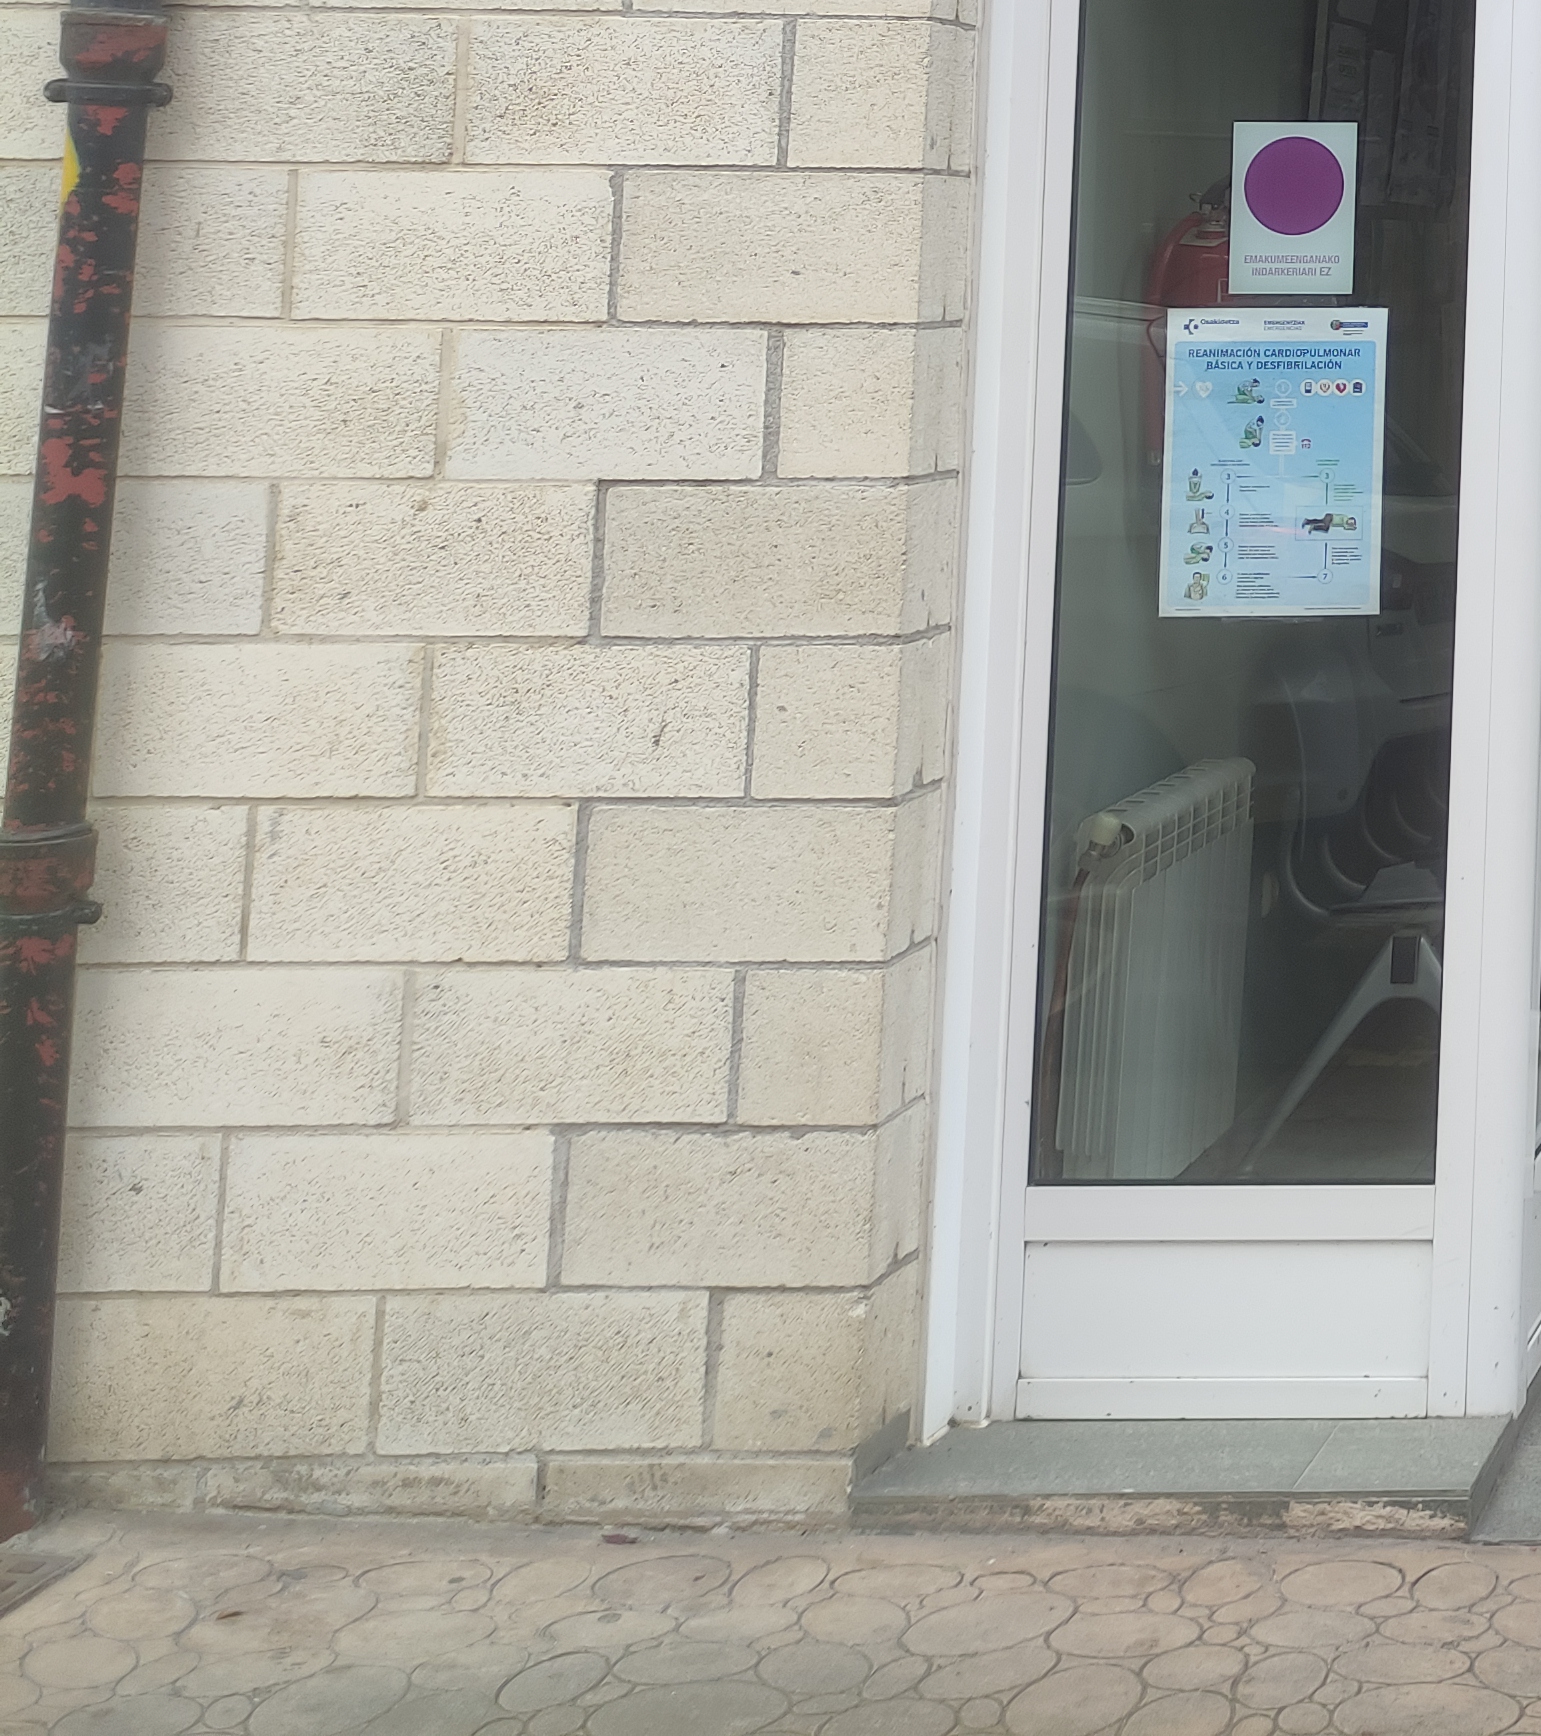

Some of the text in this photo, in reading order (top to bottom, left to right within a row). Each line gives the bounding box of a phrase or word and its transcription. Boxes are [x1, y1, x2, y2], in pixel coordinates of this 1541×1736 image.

[1244, 255, 1340, 264] EMAKUMEENGANAKO
[1252, 267, 1332, 276] INDARKERIARI EZ
[1188, 347, 1361, 358] REANIMACIÓN CARDIOPULMONAR
[1206, 359, 1342, 370] BÁSICA Y DESFIBRILACIÓN
